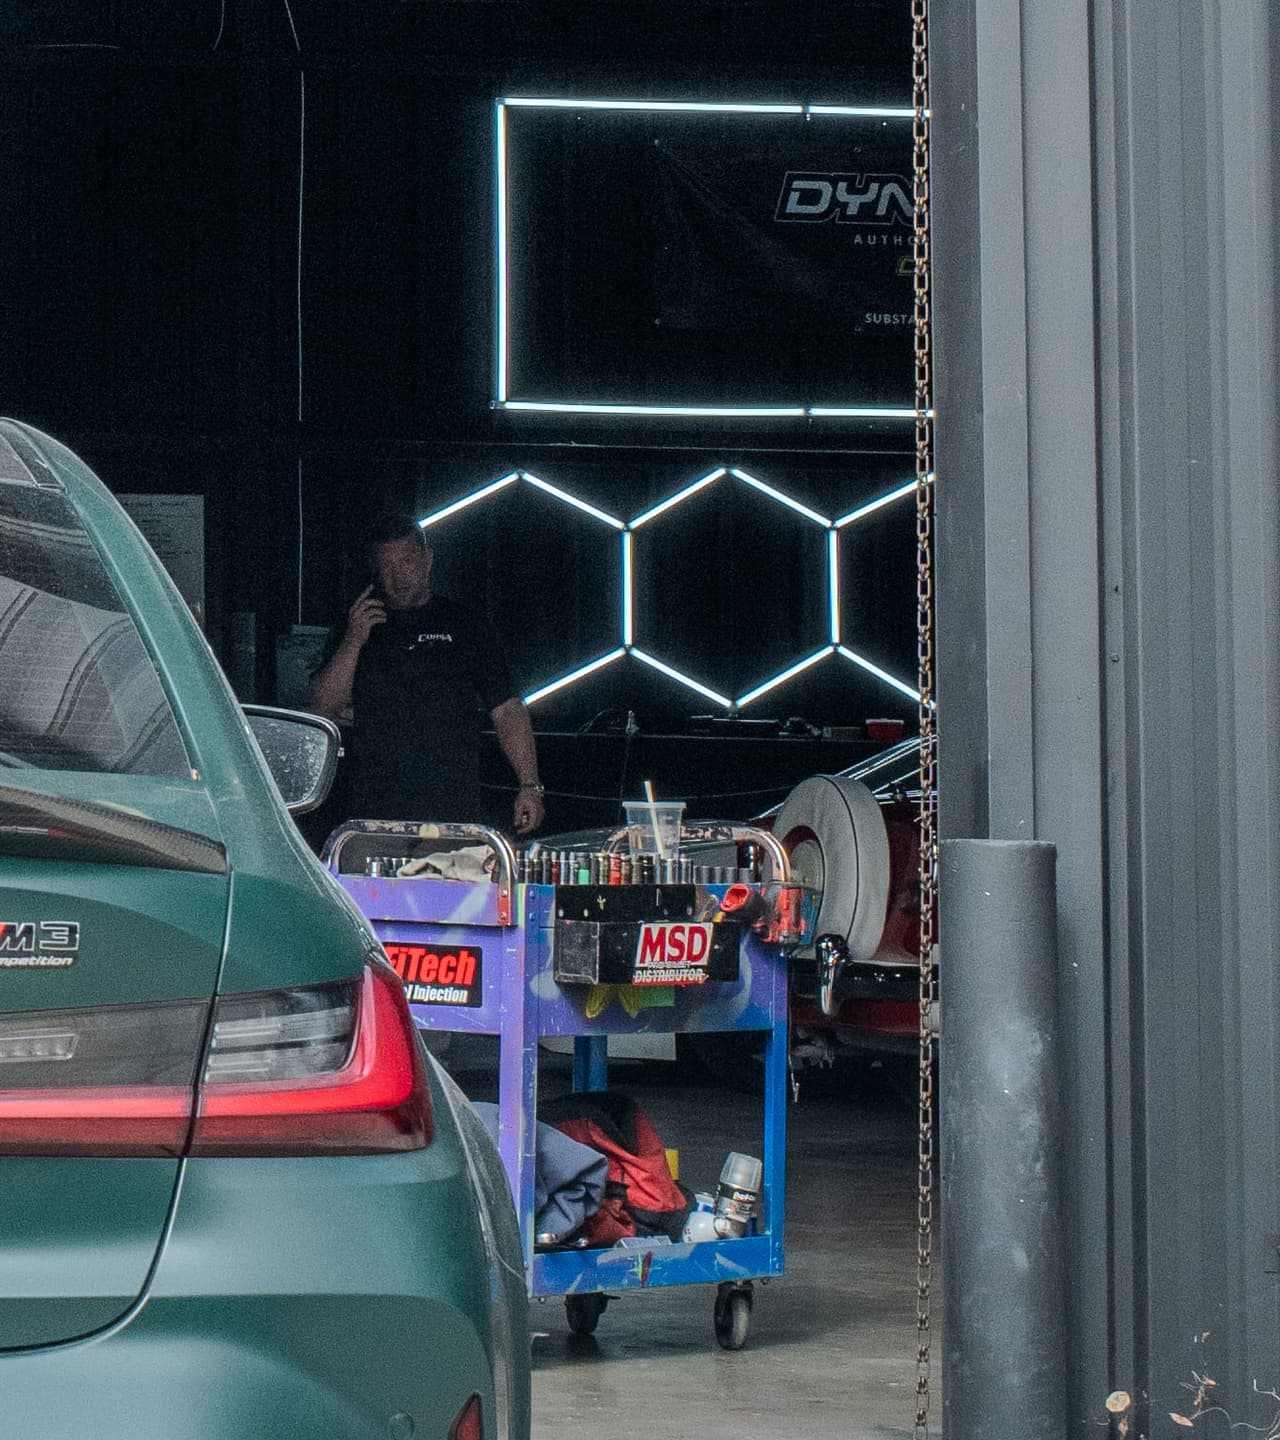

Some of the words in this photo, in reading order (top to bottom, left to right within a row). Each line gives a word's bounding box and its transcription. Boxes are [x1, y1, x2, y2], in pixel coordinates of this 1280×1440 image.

[638, 924, 708, 964] MSD
[633, 968, 705, 982] DISTRIBUTOR
[413, 984, 469, 1004] Injection
